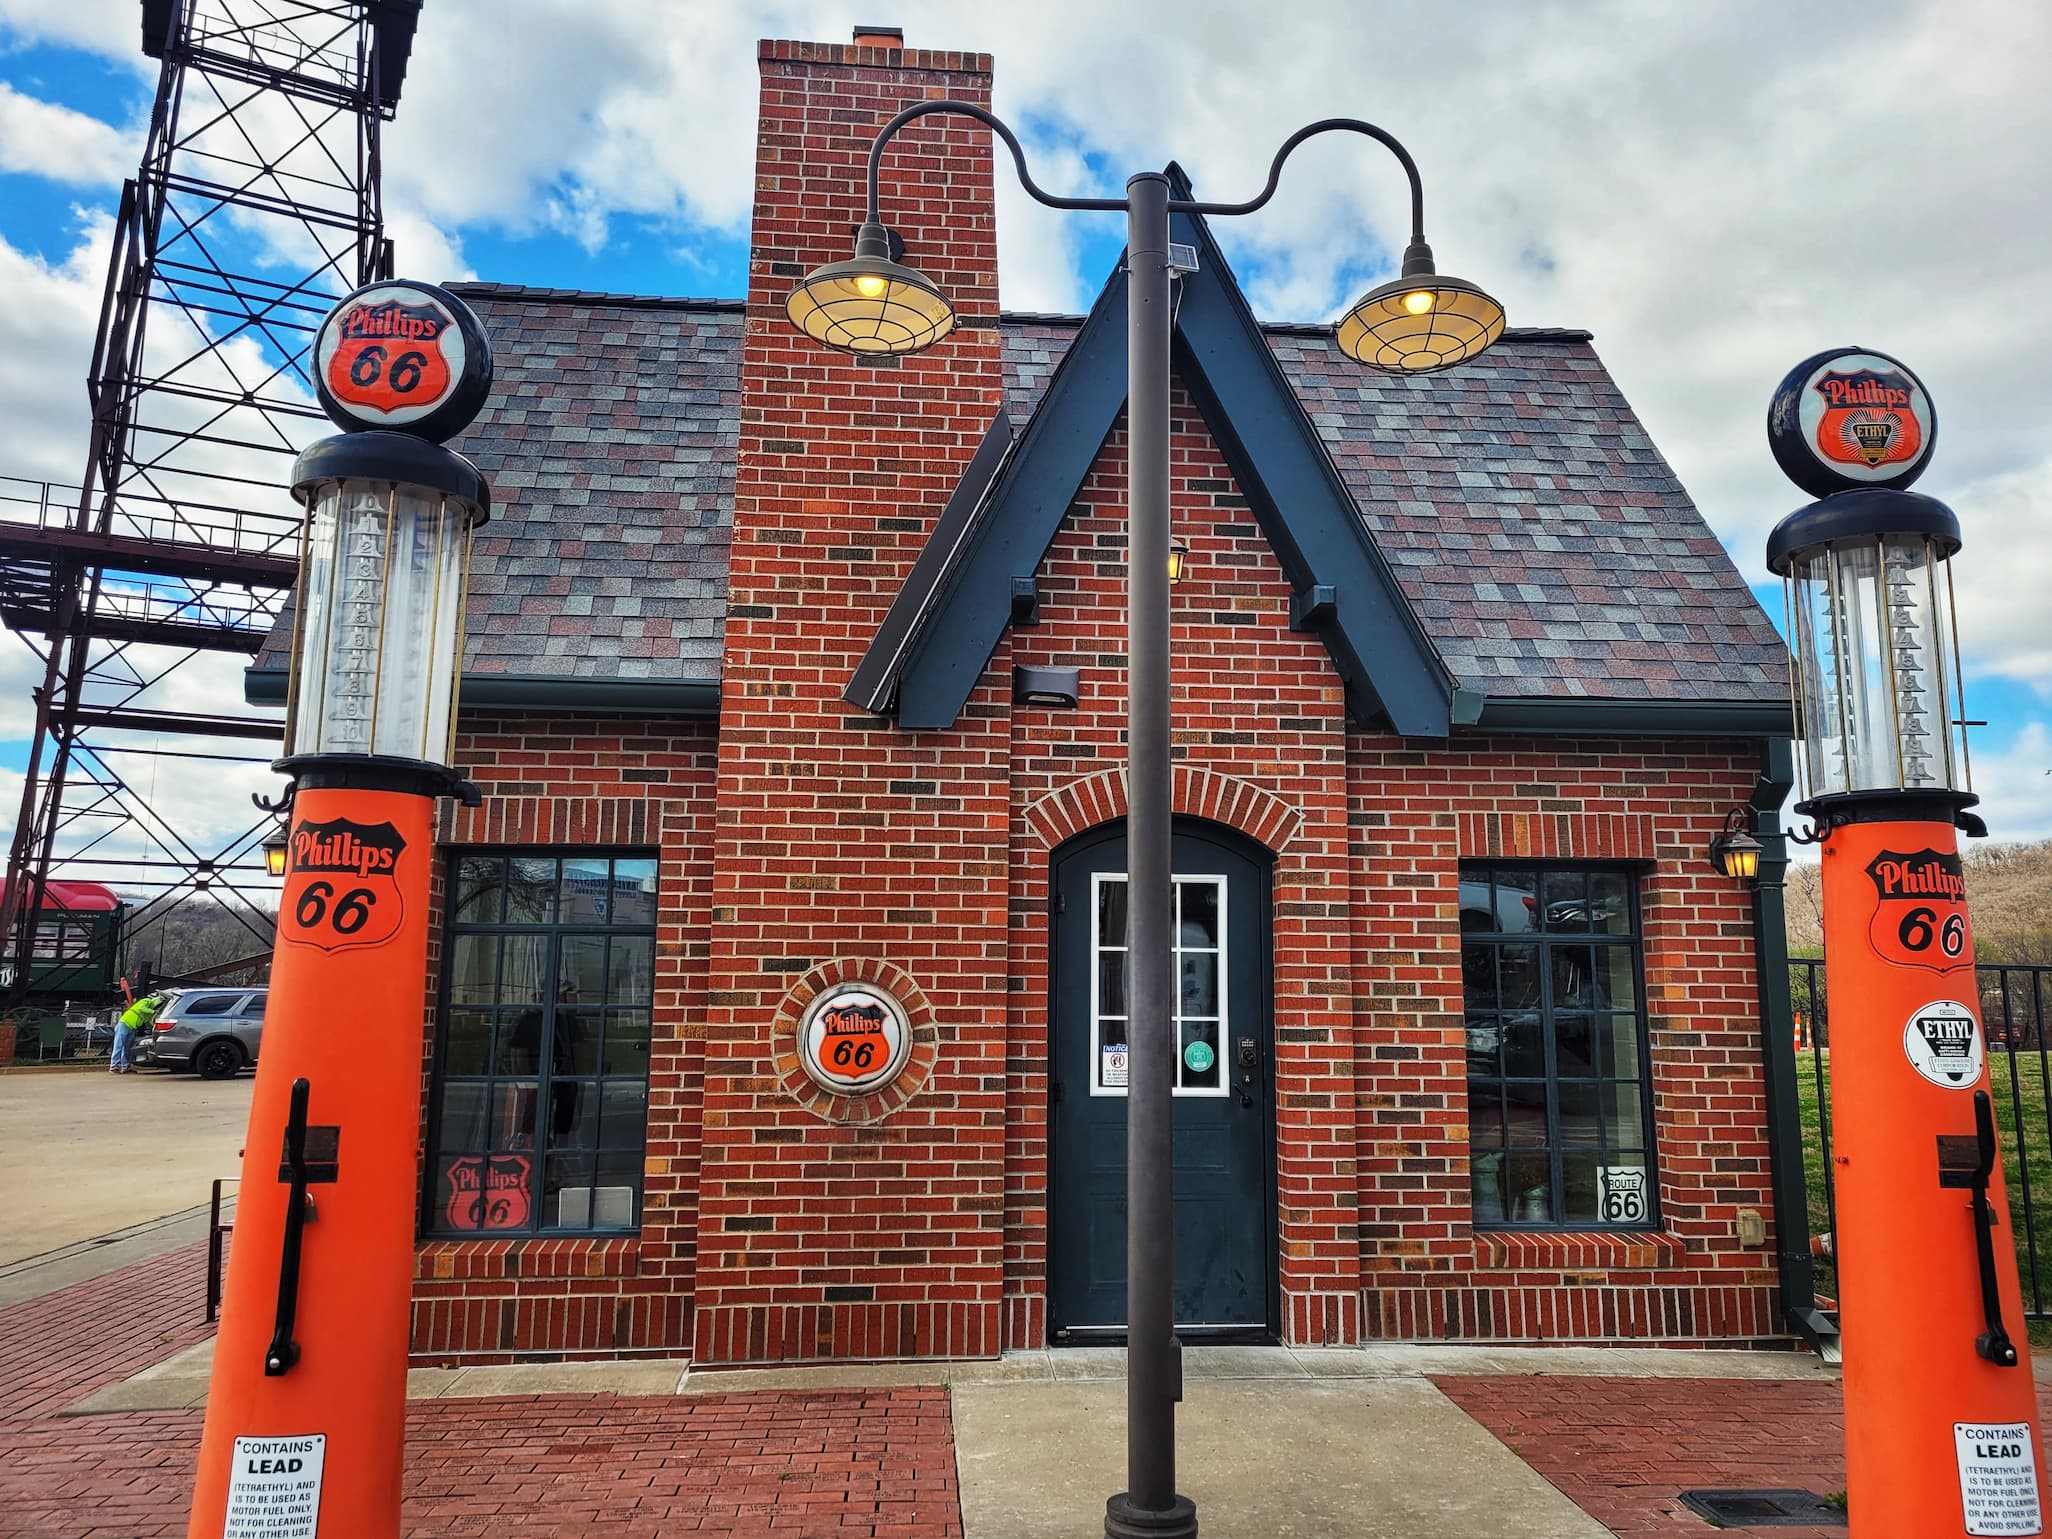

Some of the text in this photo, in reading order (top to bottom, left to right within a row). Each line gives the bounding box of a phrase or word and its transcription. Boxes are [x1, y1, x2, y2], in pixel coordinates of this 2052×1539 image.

[345, 307, 437, 344] Phillips
[350, 345, 428, 393] 66
[1824, 379, 1907, 411] Phillips
[1856, 425, 1888, 438] ETHYL
[361, 541, 371, 554] 2
[356, 588, 369, 600] 4
[356, 608, 368, 624] 5
[351, 657, 363, 670] 7
[295, 831, 393, 878] Phillips
[1875, 860, 1966, 904] Phillips
[296, 881, 377, 934] 66
[1898, 906, 1965, 958] 66
[826, 1013, 881, 1036] Phillips
[1922, 1020, 1972, 1039] ETHYL
[833, 1040, 875, 1068] 66
[456, 1167, 519, 1190] Phllips
[1608, 1179, 1638, 1189] ROUTE
[468, 1197, 511, 1225] 66
[1608, 1192, 1639, 1218] 66
[1965, 1428, 2024, 1440] CONTAINS
[243, 1441, 313, 1454] CONTAINS
[1976, 1444, 2021, 1458] LEAD
[248, 1459, 303, 1474] LEAD
[2021, 1465, 2033, 1474] AND
[234, 1480, 316, 1492] (TETRAETHYL) AND
[1981, 1478, 1991, 1486] TO
[1994, 1478, 2002, 1486] BE
[2005, 1477, 2023, 1486] USED
[235, 1493, 311, 1504] IS TO BE USED AS
[1968, 1488, 1998, 1497] MOTOR
[2000, 1488, 2018, 1497] FUEL
[1968, 1499, 1986, 1507] NOT
[1988, 1499, 2004, 1508] FOR
[231, 1506, 261, 1516] MOTOR
[263, 1506, 284, 1516] FUEL
[1983, 1511, 2000, 1519] ANY
[2002, 1510, 2026, 1519] OTHER
[229, 1516, 313, 1528] NOT FOR CLEANING
[1978, 1520, 2035, 1530] AVOID SPILLING
[227, 1530, 238, 1539] OR
[239, 1530, 257, 1539] ANY
[259, 1529, 289, 1539] OTHER
